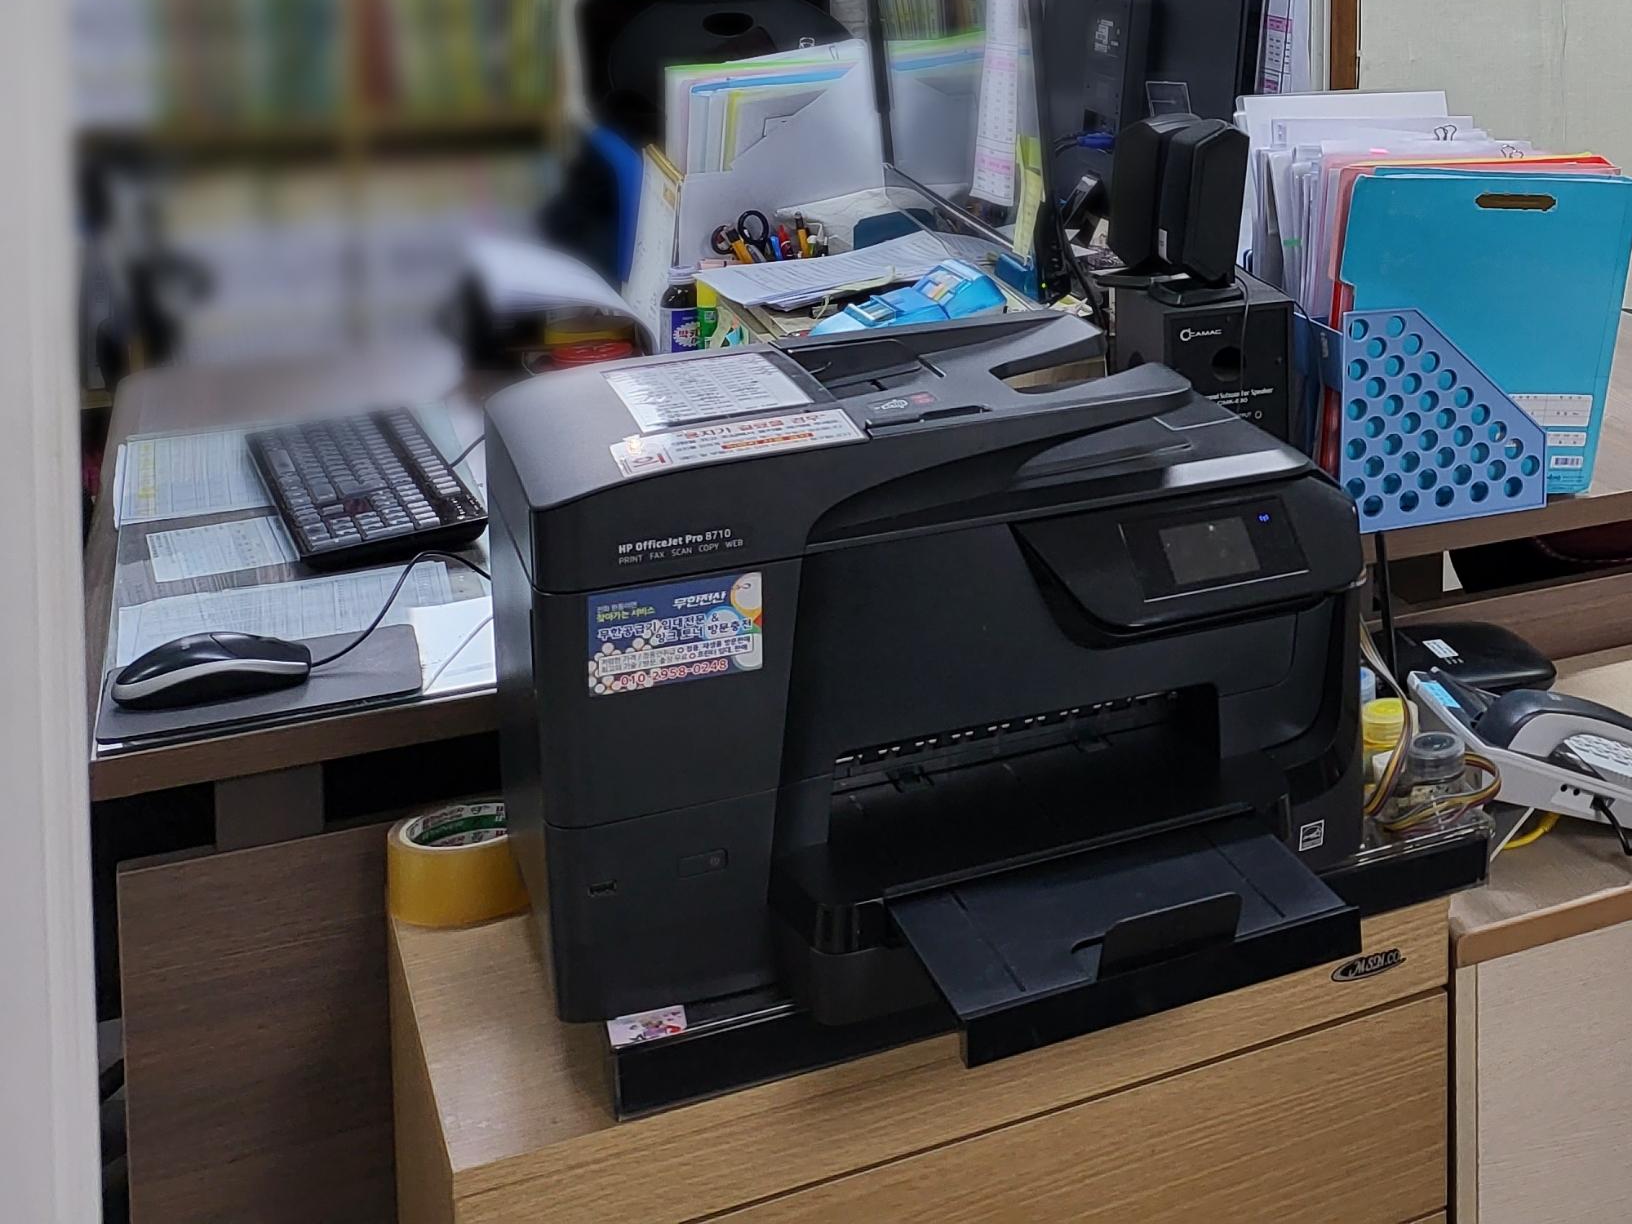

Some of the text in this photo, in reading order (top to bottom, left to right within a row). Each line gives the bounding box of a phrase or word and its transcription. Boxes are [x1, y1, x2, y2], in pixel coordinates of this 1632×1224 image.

[619, 528, 731, 554] HP OfficeJet Pro 8710
[619, 539, 743, 565] PRINT FAX SCAN COPY WEB
